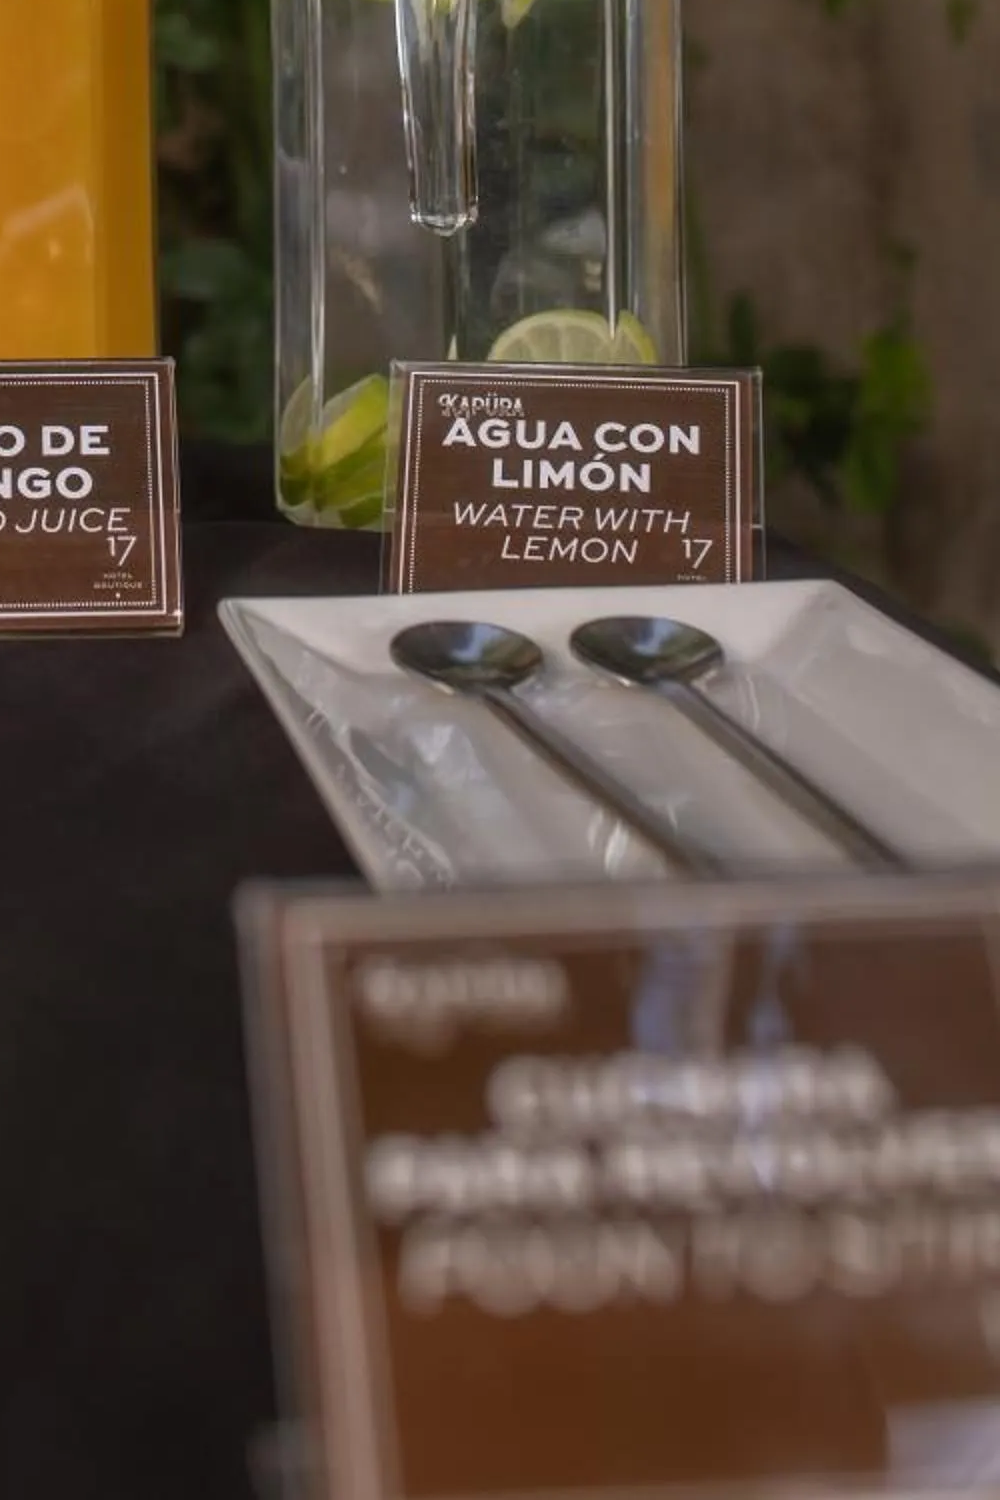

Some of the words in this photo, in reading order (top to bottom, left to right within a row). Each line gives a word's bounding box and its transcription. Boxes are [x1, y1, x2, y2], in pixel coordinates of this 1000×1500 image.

[41, 425, 110, 456] DE
[442, 417, 583, 451] AGUA
[594, 422, 700, 455] CON
[492, 453, 651, 493] LIMÓN
[14, 507, 131, 534] JUICE
[454, 501, 585, 530] WATER
[595, 507, 691, 534] WITH
[106, 535, 137, 566] 17
[500, 536, 639, 564] LEMON
[681, 539, 713, 569] 17
